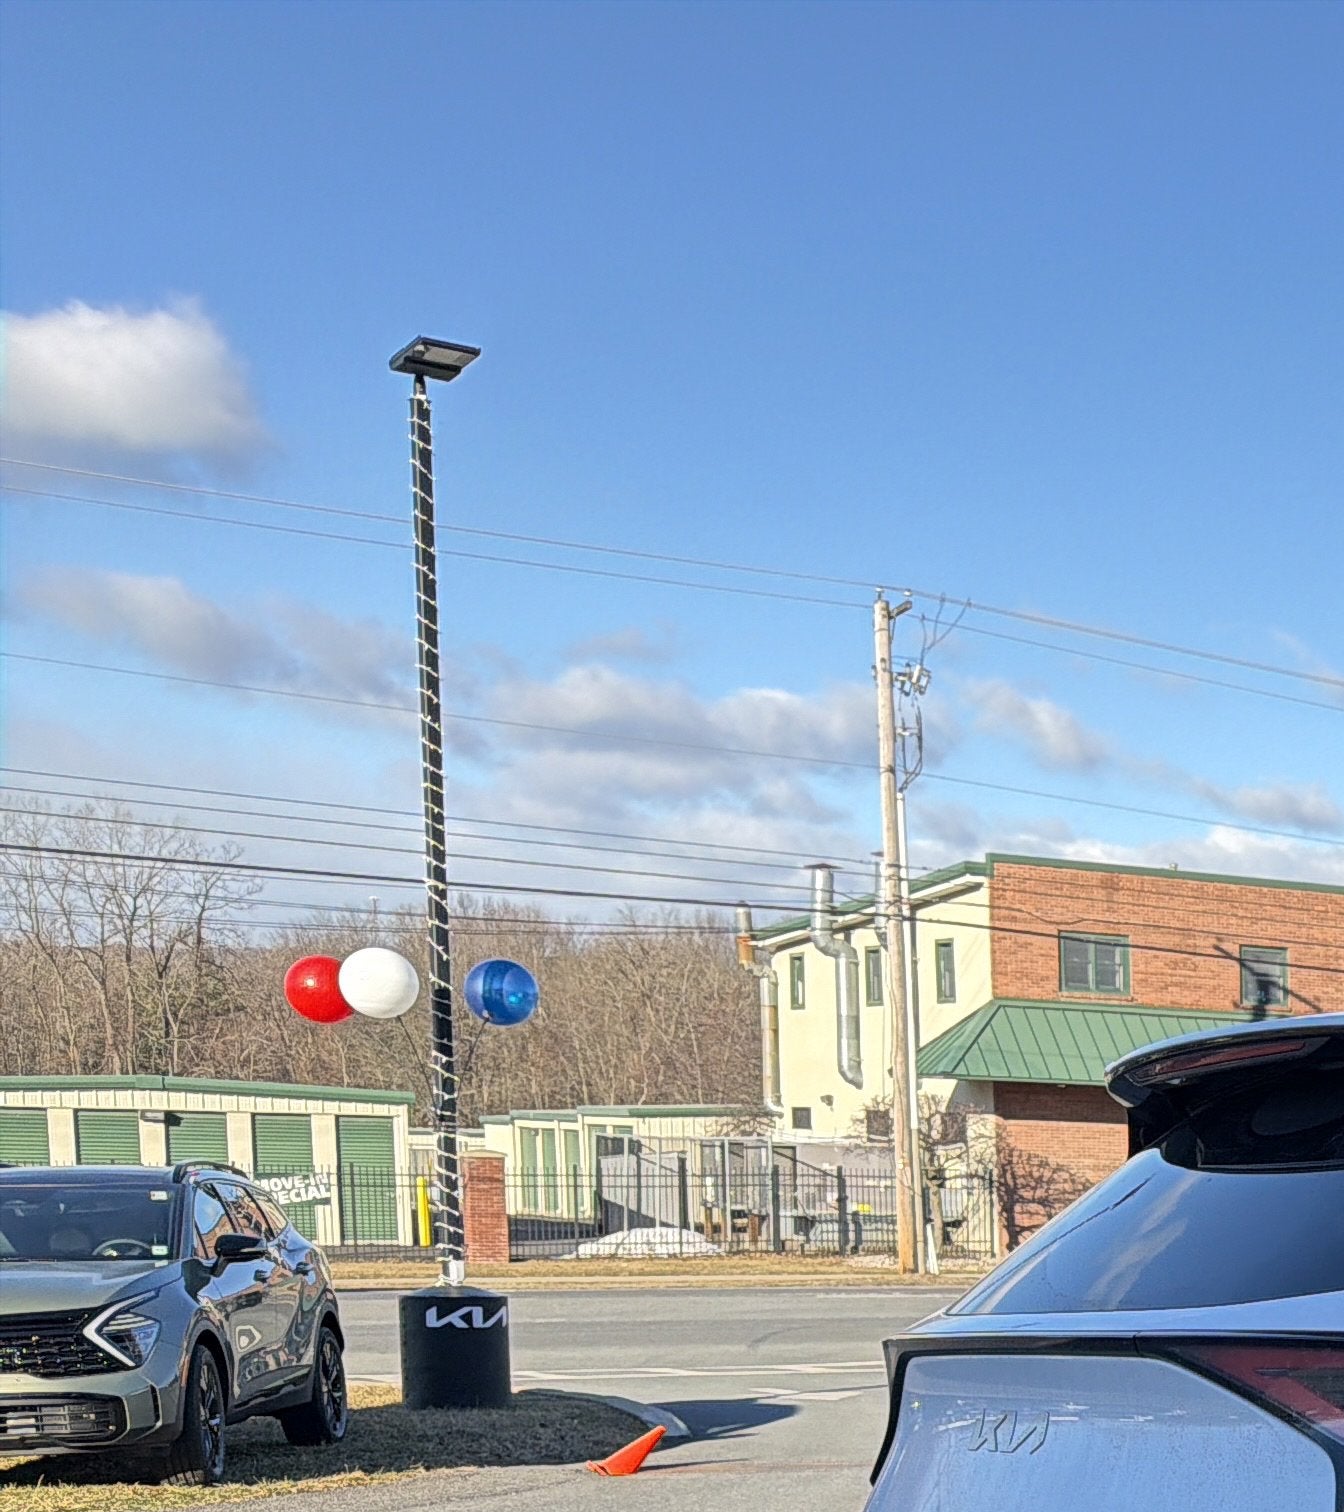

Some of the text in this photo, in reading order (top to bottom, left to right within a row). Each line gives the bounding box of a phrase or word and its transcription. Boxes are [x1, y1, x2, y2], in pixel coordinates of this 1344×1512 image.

[271, 1184, 331, 1205] ECIAL
[425, 1305, 507, 1329] KIA
[966, 1408, 1050, 1456] KIA
